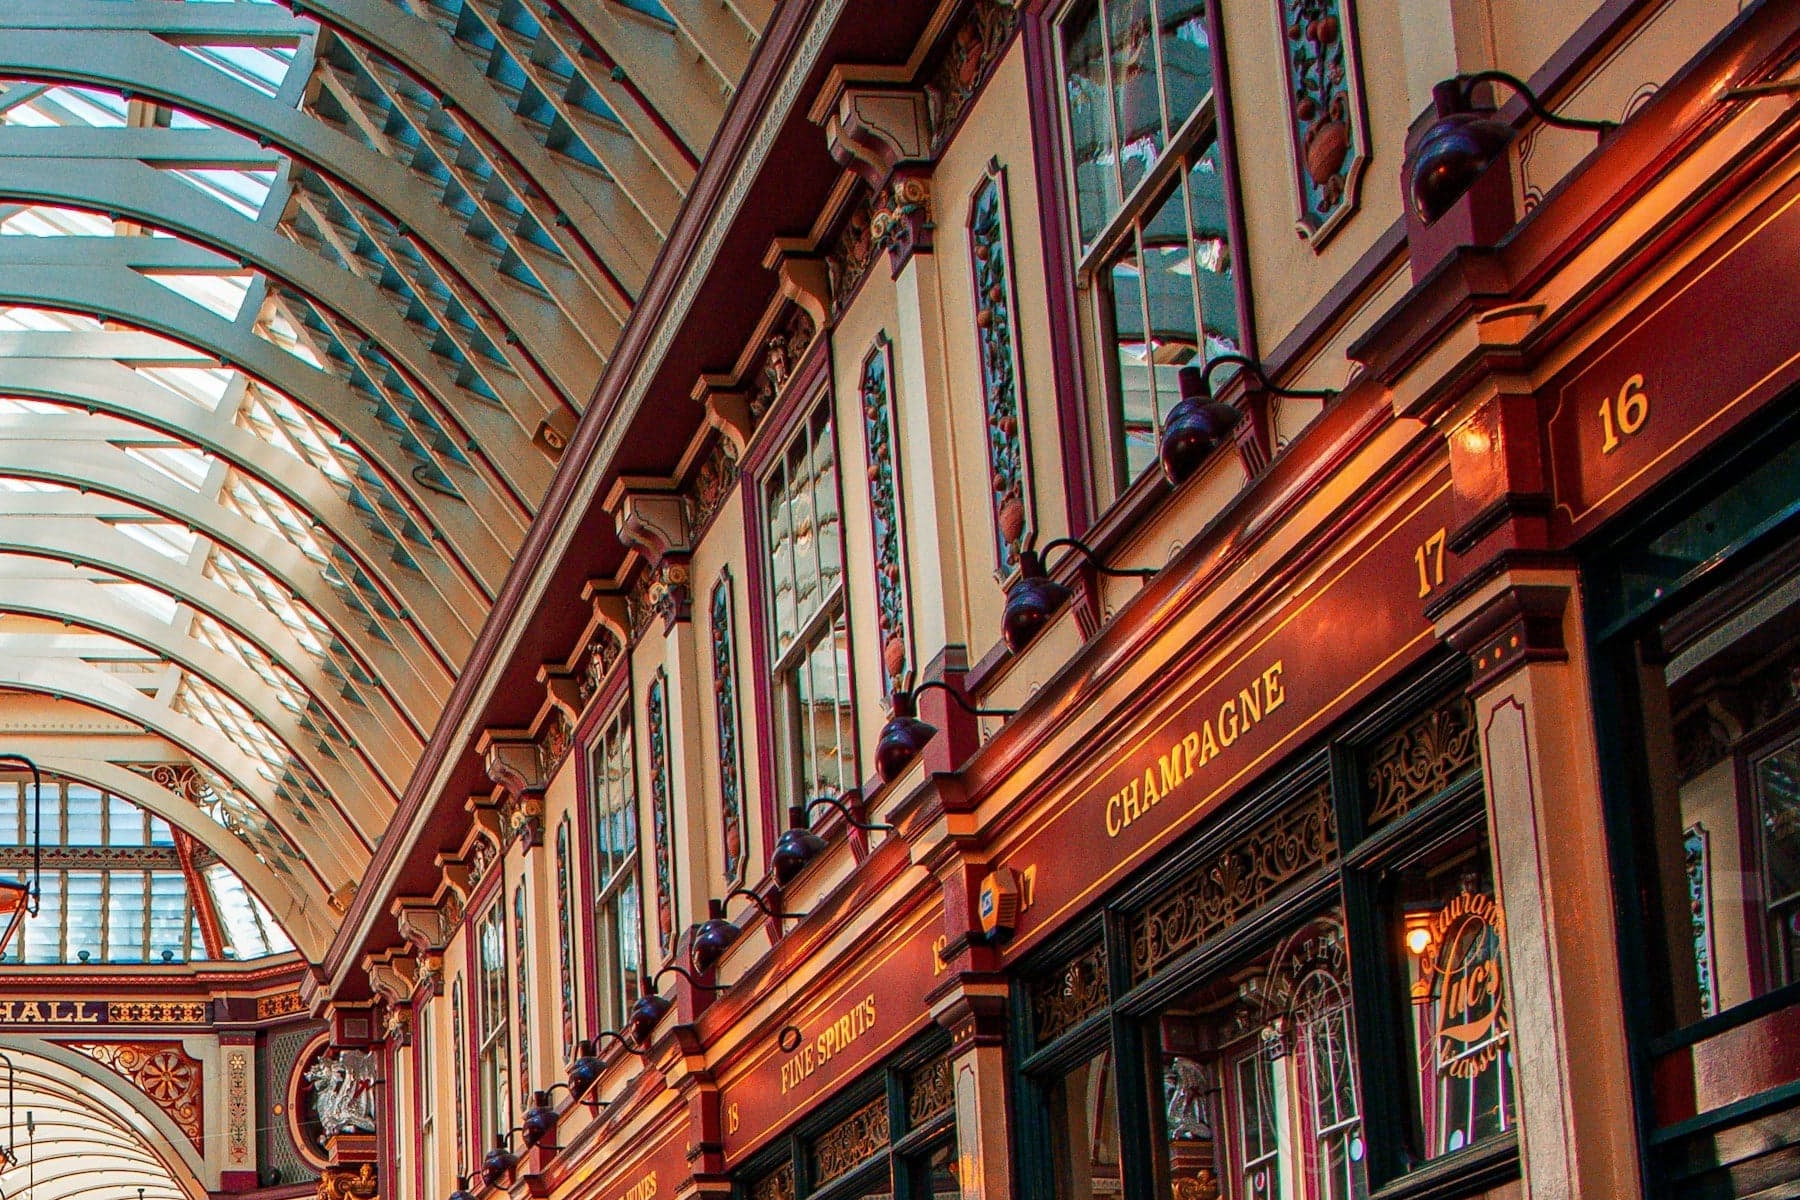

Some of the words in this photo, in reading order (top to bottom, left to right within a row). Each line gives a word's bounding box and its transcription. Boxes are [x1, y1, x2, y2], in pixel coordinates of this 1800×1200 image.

[1599, 374, 1648, 454] 16
[1414, 527, 1446, 598] 17
[1106, 660, 1285, 838] CHAMPAGNE
[780, 1044, 815, 1095] FINE
[817, 994, 876, 1067] SPIRITS
[727, 1102, 739, 1135] 18
